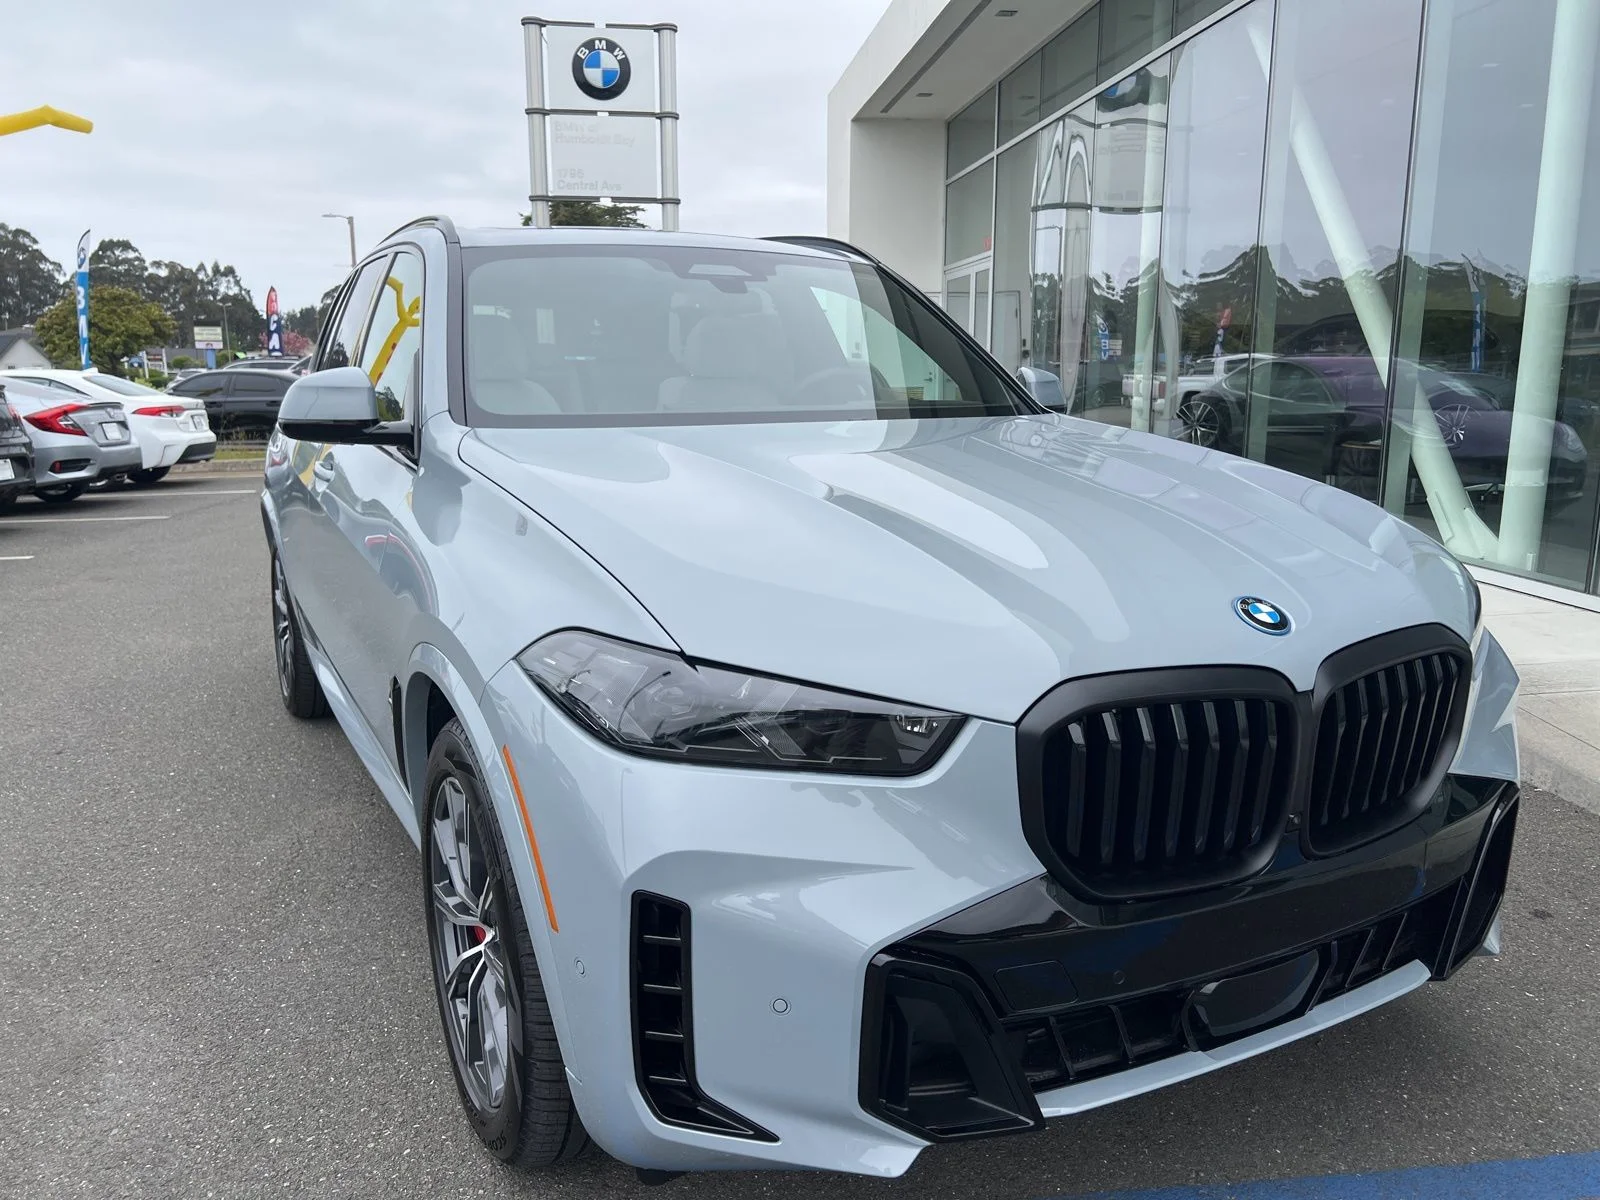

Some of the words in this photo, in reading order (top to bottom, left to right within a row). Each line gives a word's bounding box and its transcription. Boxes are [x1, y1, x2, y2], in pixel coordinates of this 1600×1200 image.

[577, 39, 626, 60] BMW
[557, 179, 598, 191] Central
[601, 180, 622, 191] Ave
